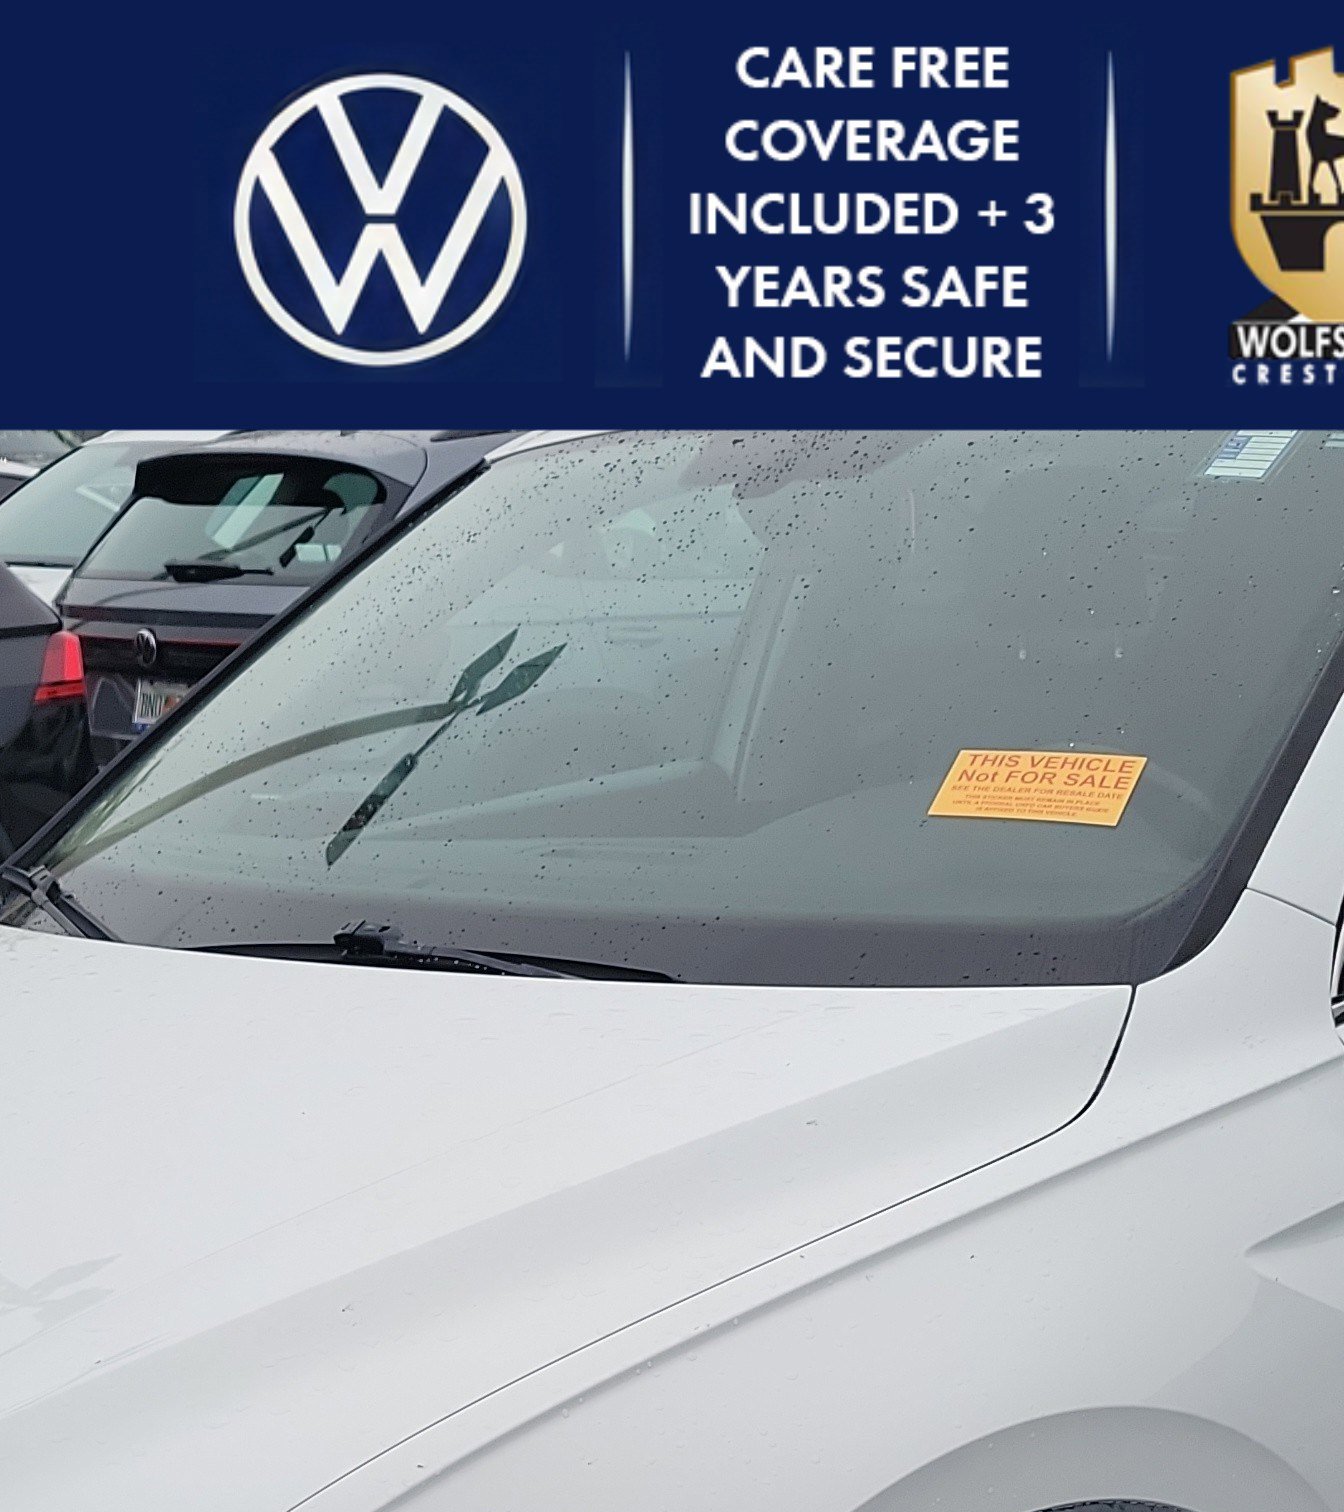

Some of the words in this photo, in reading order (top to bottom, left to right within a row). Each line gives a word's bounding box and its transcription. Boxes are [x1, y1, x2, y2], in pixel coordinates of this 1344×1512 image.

[969, 754, 1022, 768] THIS
[1030, 755, 1137, 774] VEHICLE
[957, 769, 998, 783] Not
[1004, 770, 1057, 785] FOR
[1063, 773, 1133, 790] SALE
[992, 786, 1032, 794] DEALER
[1056, 789, 1096, 798] RESALE
[1097, 792, 1126, 800] DATE
